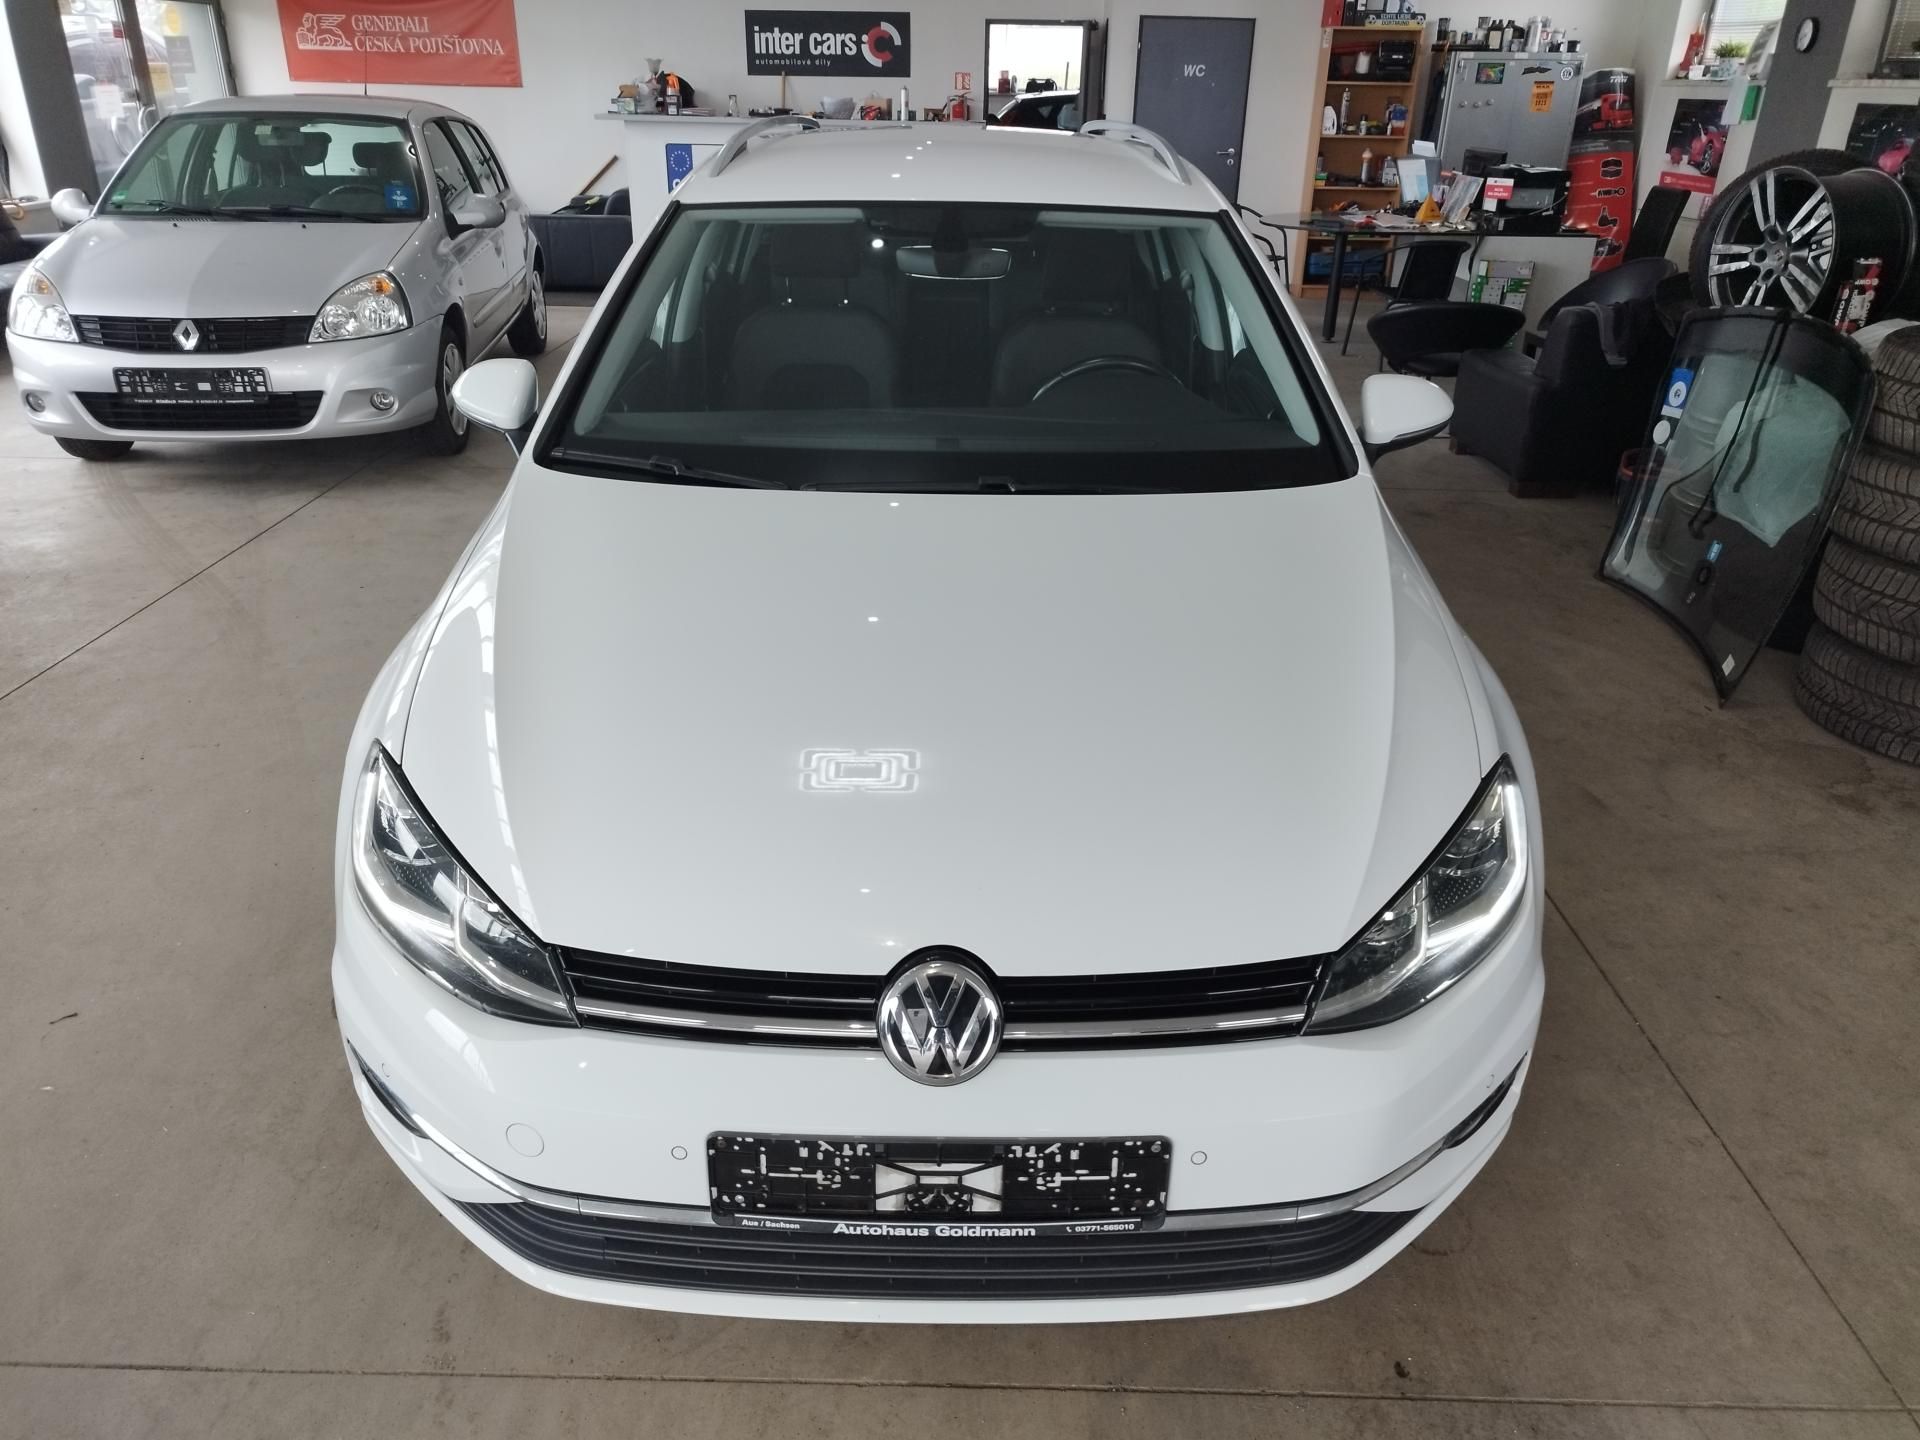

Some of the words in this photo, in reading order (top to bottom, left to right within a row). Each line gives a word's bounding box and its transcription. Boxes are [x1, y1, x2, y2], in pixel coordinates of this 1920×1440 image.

[352, 15, 430, 33] GENERALI
[354, 33, 406, 53] ČESKÁ
[409, 35, 505, 55] POJIŠŤOVNA
[754, 26, 803, 55] inter
[809, 32, 857, 56] cars
[1184, 64, 1206, 77] WC
[765, 1220, 800, 1230] Sachsen
[833, 1223, 930, 1237] Autohaus
[935, 1225, 1036, 1237] Goldmann
